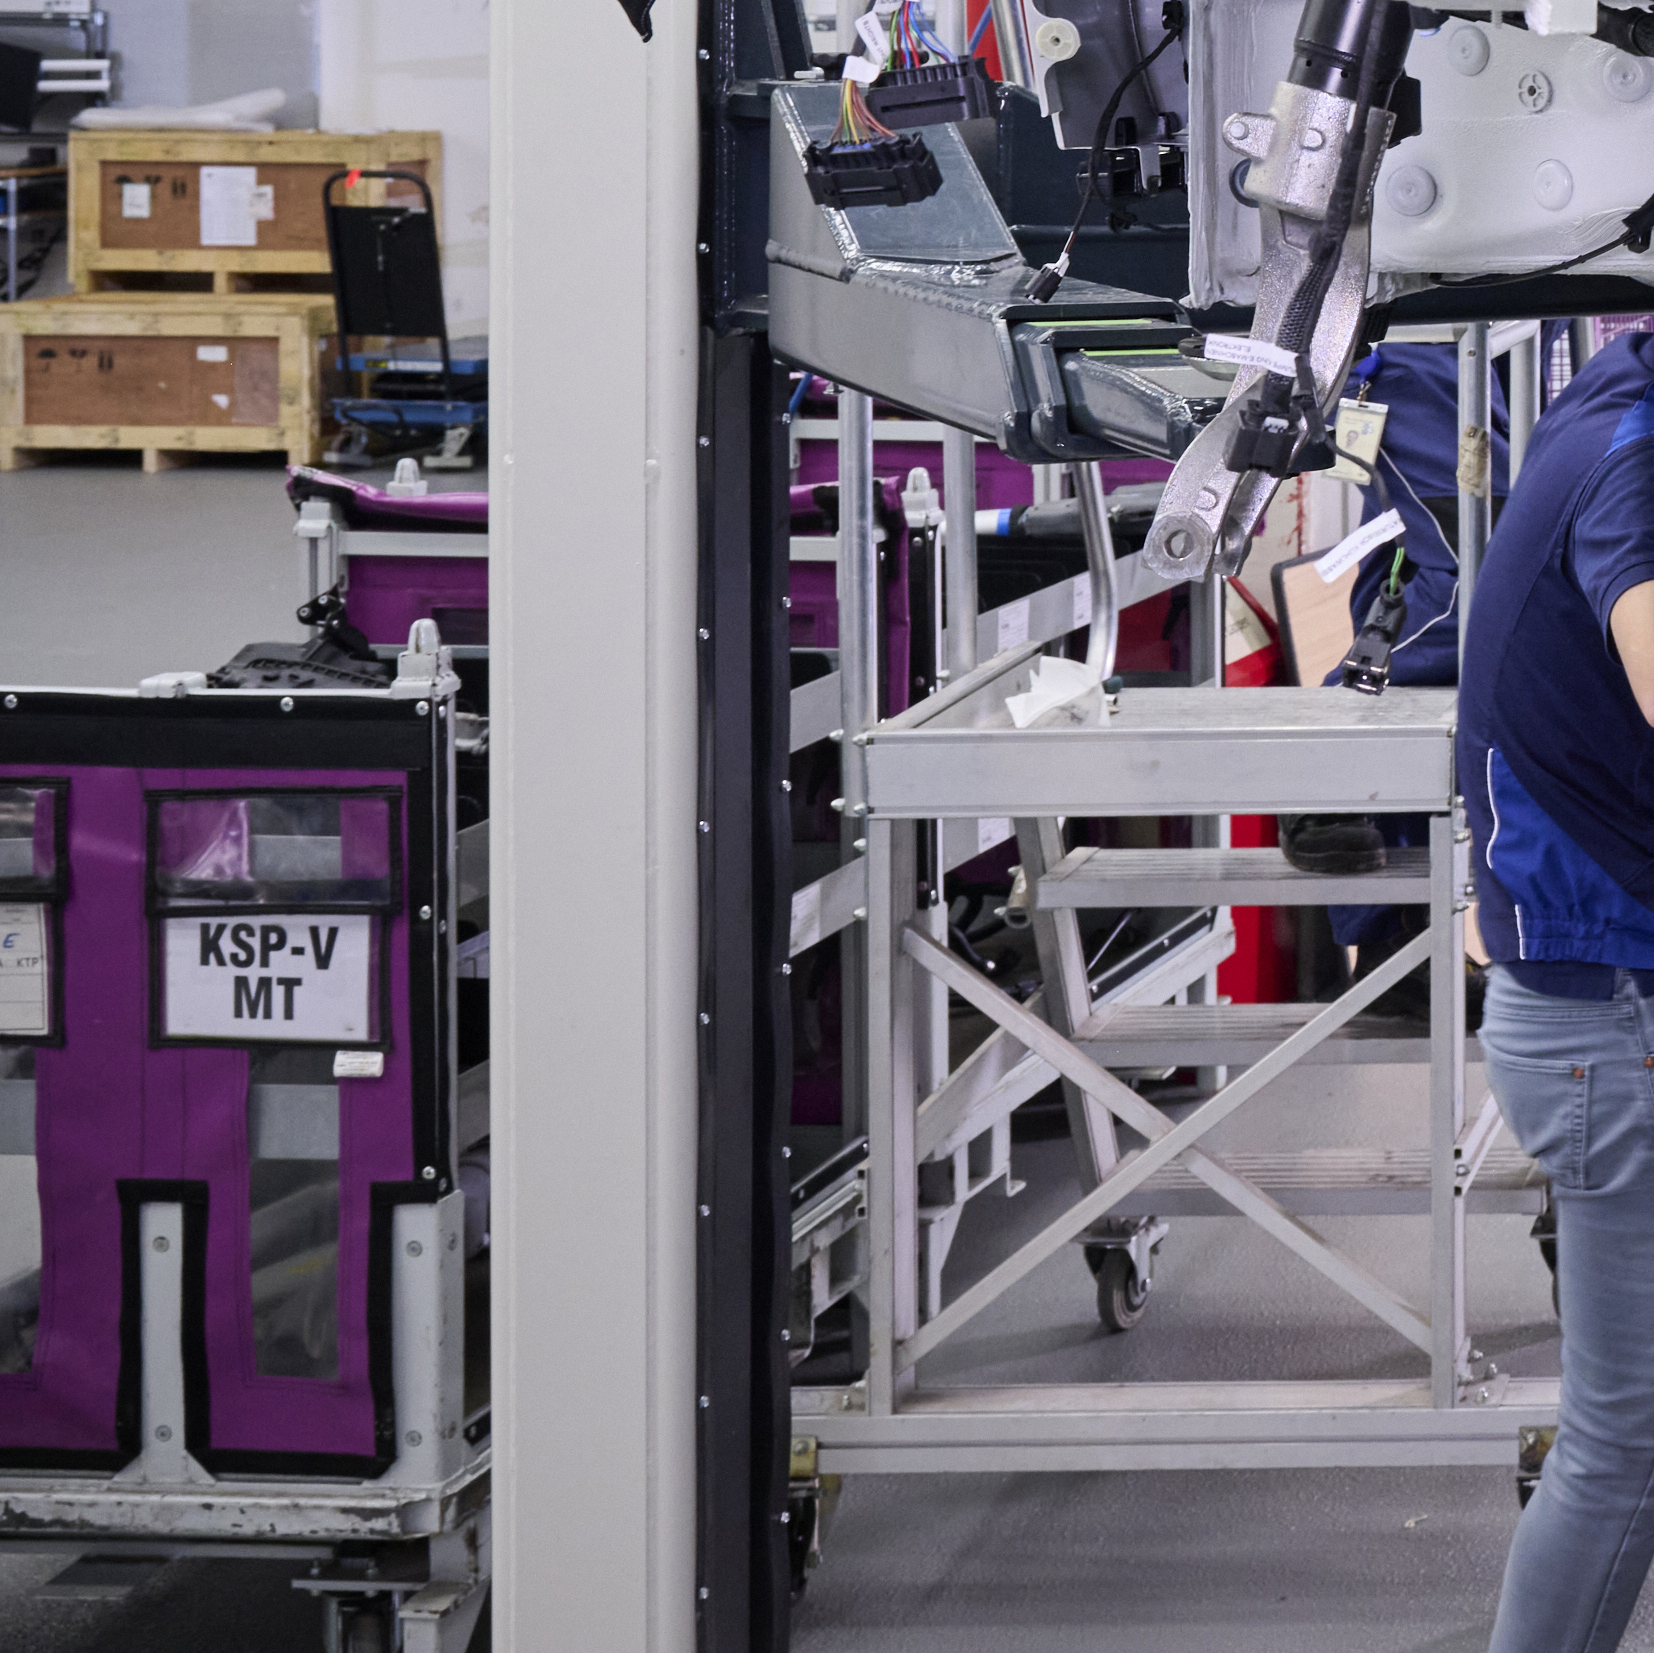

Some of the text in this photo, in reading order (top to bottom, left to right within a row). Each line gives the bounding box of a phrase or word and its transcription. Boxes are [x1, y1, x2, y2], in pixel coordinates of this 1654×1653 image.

[1208, 340, 1251, 354] ELEKTRONIK
[200, 922, 339, 971] KSP-V
[234, 975, 303, 1021] MT
